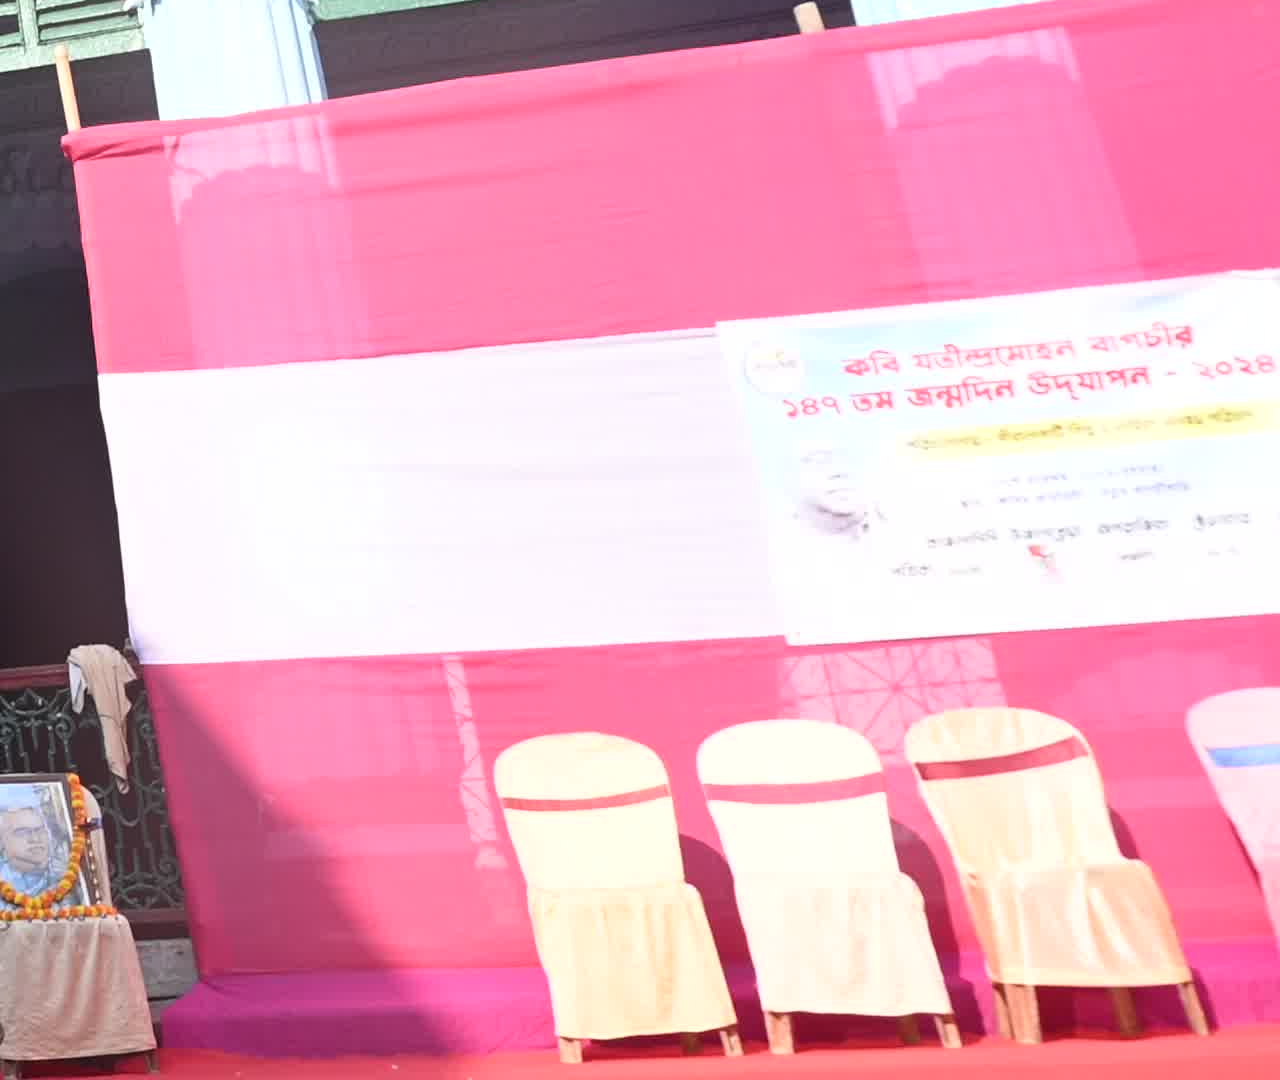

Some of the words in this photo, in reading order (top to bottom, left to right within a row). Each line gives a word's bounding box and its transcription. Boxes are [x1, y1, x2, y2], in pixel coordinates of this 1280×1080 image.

[843, 349, 900, 377] কবি
[782, 396, 841, 419] ১৪৭
[850, 390, 894, 414] তম
[907, 376, 1016, 409] জন্মদিন
